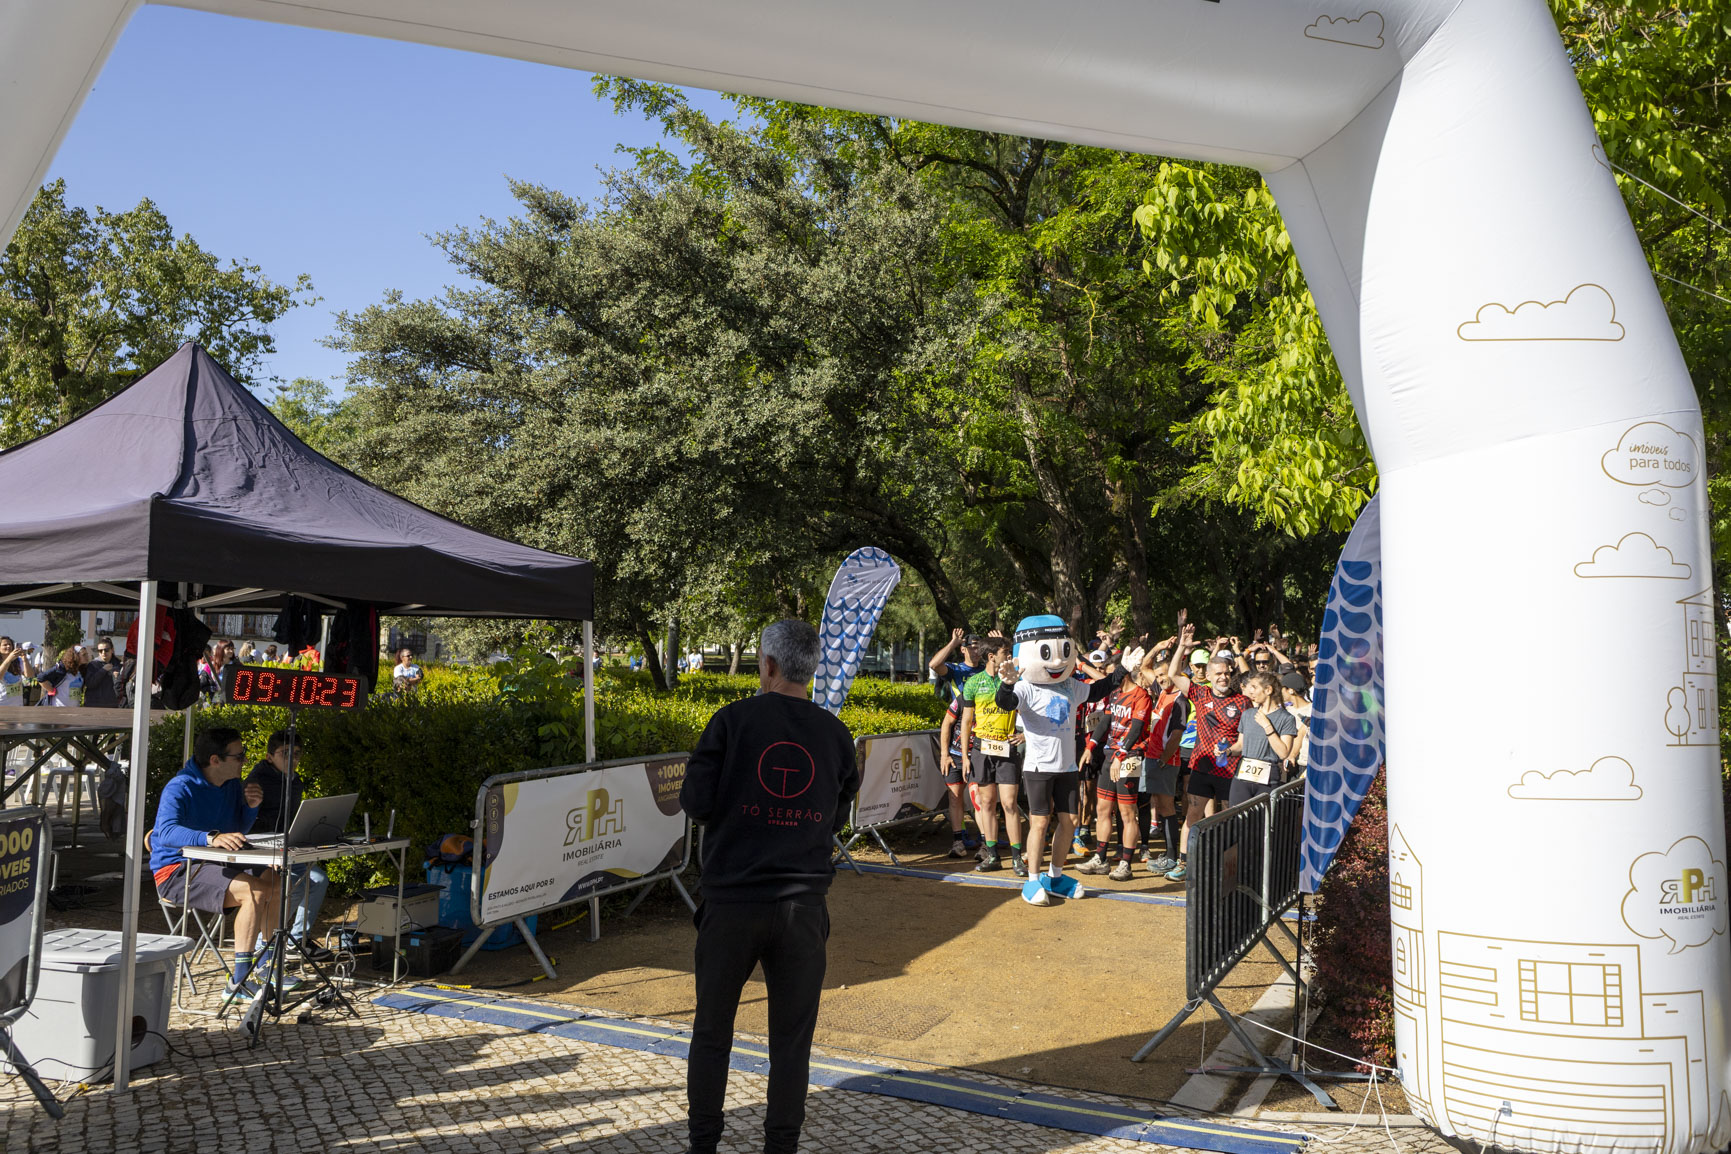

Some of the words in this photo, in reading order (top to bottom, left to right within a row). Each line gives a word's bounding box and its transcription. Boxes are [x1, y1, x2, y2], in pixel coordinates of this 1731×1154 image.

[1629, 442, 1669, 456] imóveis
[1629, 458, 1660, 471] para
[1663, 457, 1691, 473] todos
[233, 670, 358, 708] 09:10:23
[988, 743, 1004, 751] 186
[657, 762, 686, 779] +1000
[1245, 764, 1264, 776] 207
[742, 803, 760, 816] TÓ
[768, 807, 822, 823] SERRÃO
[768, 819, 798, 827] SPEAKER
[562, 838, 622, 862] IMOBILIÁRIA
[0, 856, 31, 880] VEIS
[488, 886, 519, 901] ESTAMOS
[520, 882, 535, 894] AQUI
[535, 878, 548, 890] POR
[549, 877, 555, 886] SI
[1660, 904, 1716, 915] IMOBILIÁRIA
